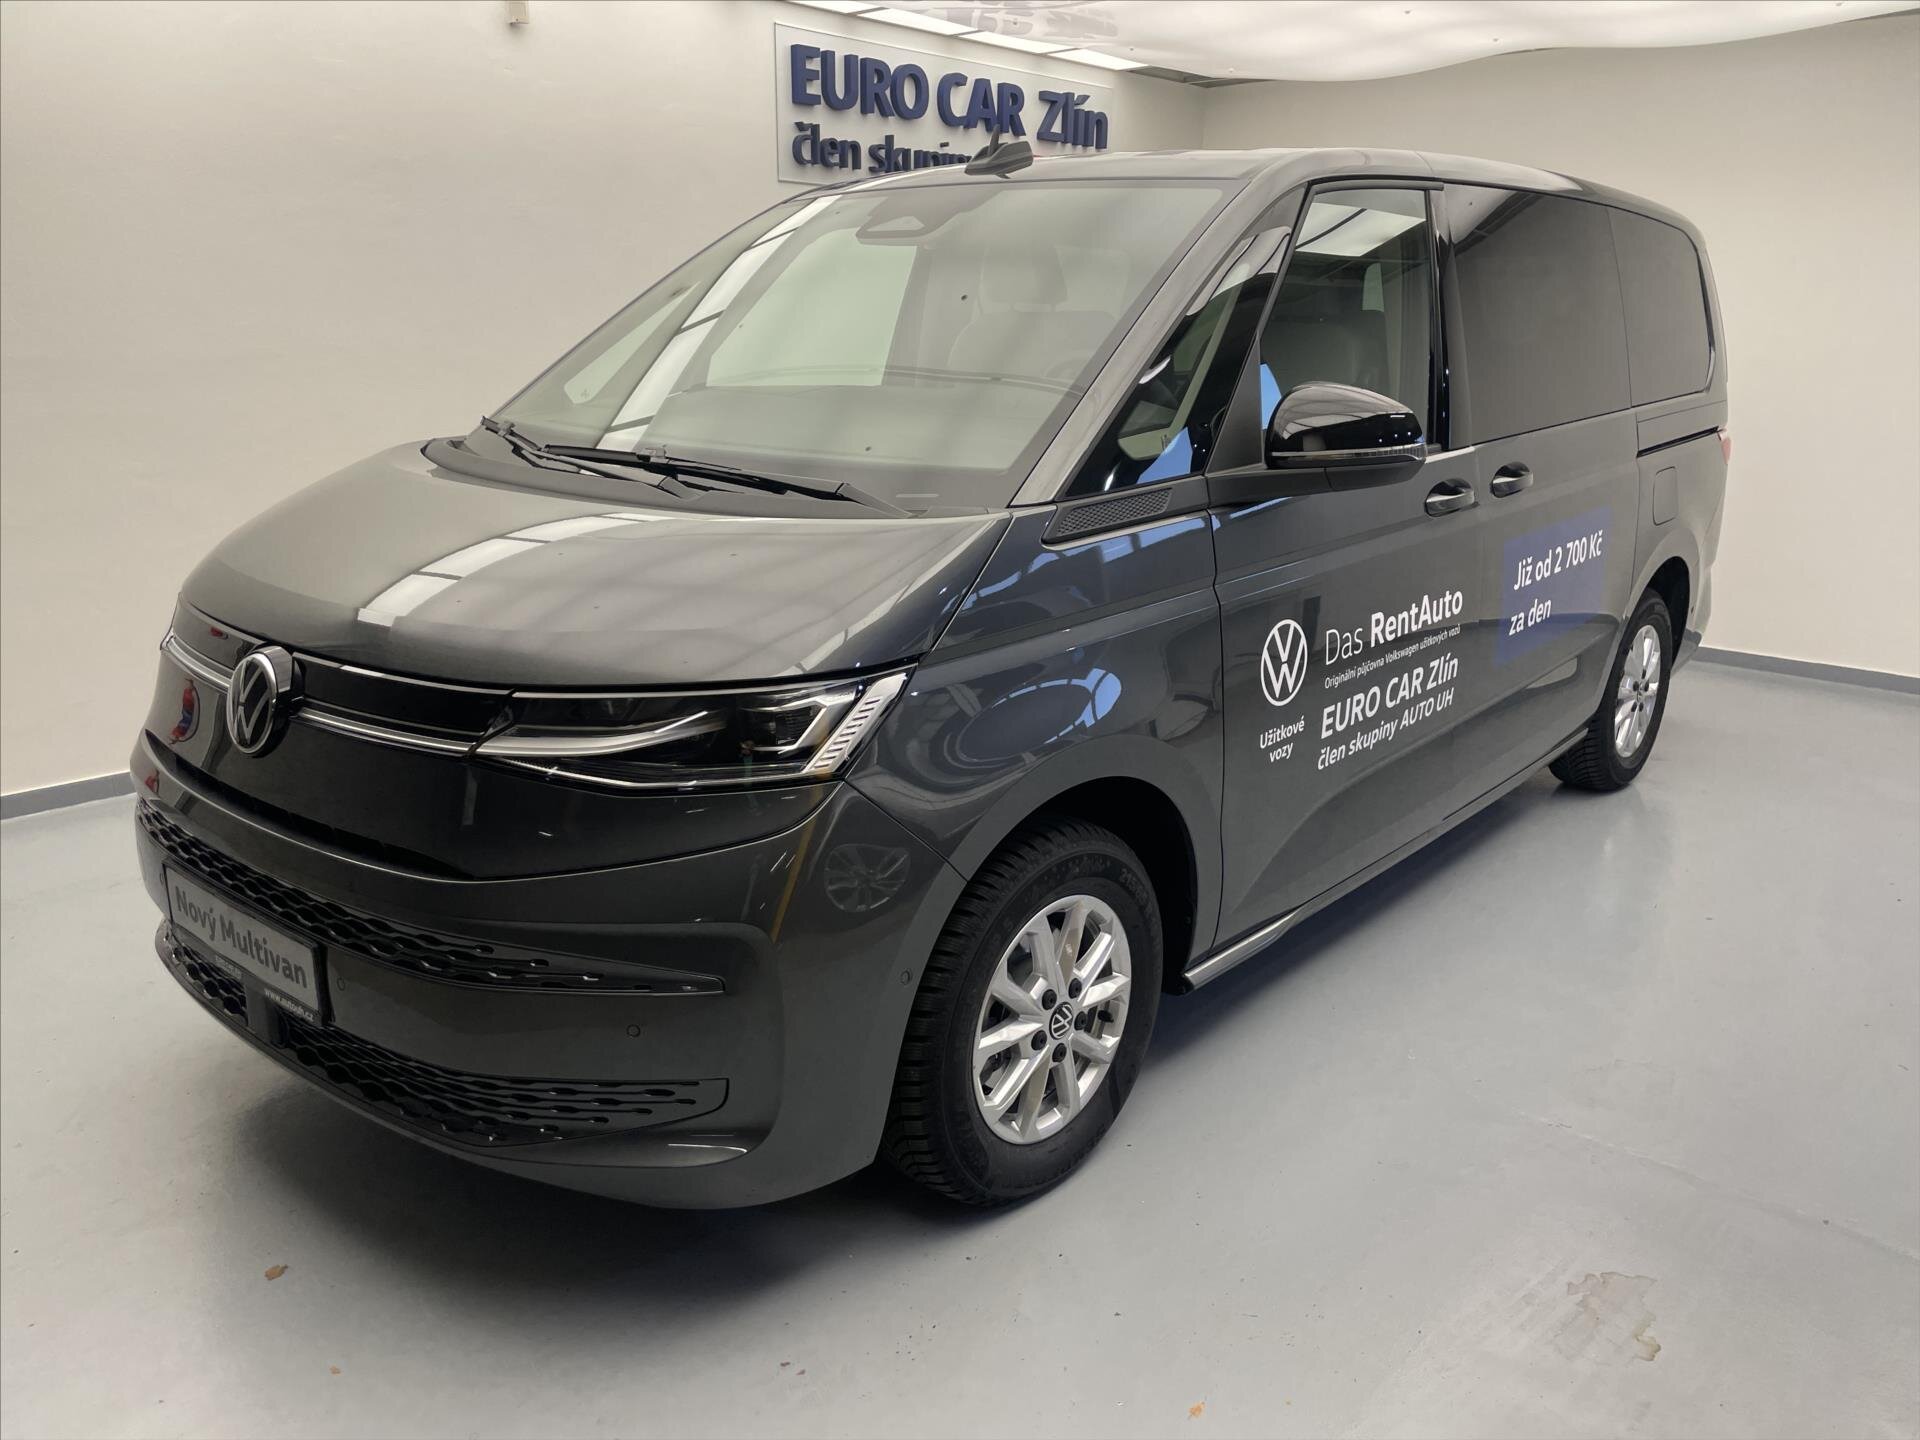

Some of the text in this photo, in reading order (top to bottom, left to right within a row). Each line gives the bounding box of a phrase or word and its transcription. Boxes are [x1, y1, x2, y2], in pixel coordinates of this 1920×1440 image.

[791, 44, 1108, 149] EURO CAR Zlín
[792, 121, 972, 172] člen skupi
[1513, 529, 1603, 590] Již od 2 700 Kč
[1325, 590, 1463, 665] Das RentAuto
[1509, 598, 1552, 636] za den
[1385, 643, 1420, 664] Volkswagen
[1320, 652, 1459, 739] EURO CAR Zlín
[1259, 715, 1305, 749] Užitkové
[1269, 742, 1294, 763] vozy
[1317, 687, 1455, 770] člen skupiny AUTO UH
[175, 886, 217, 942] Nový
[219, 914, 308, 989] Multivan
